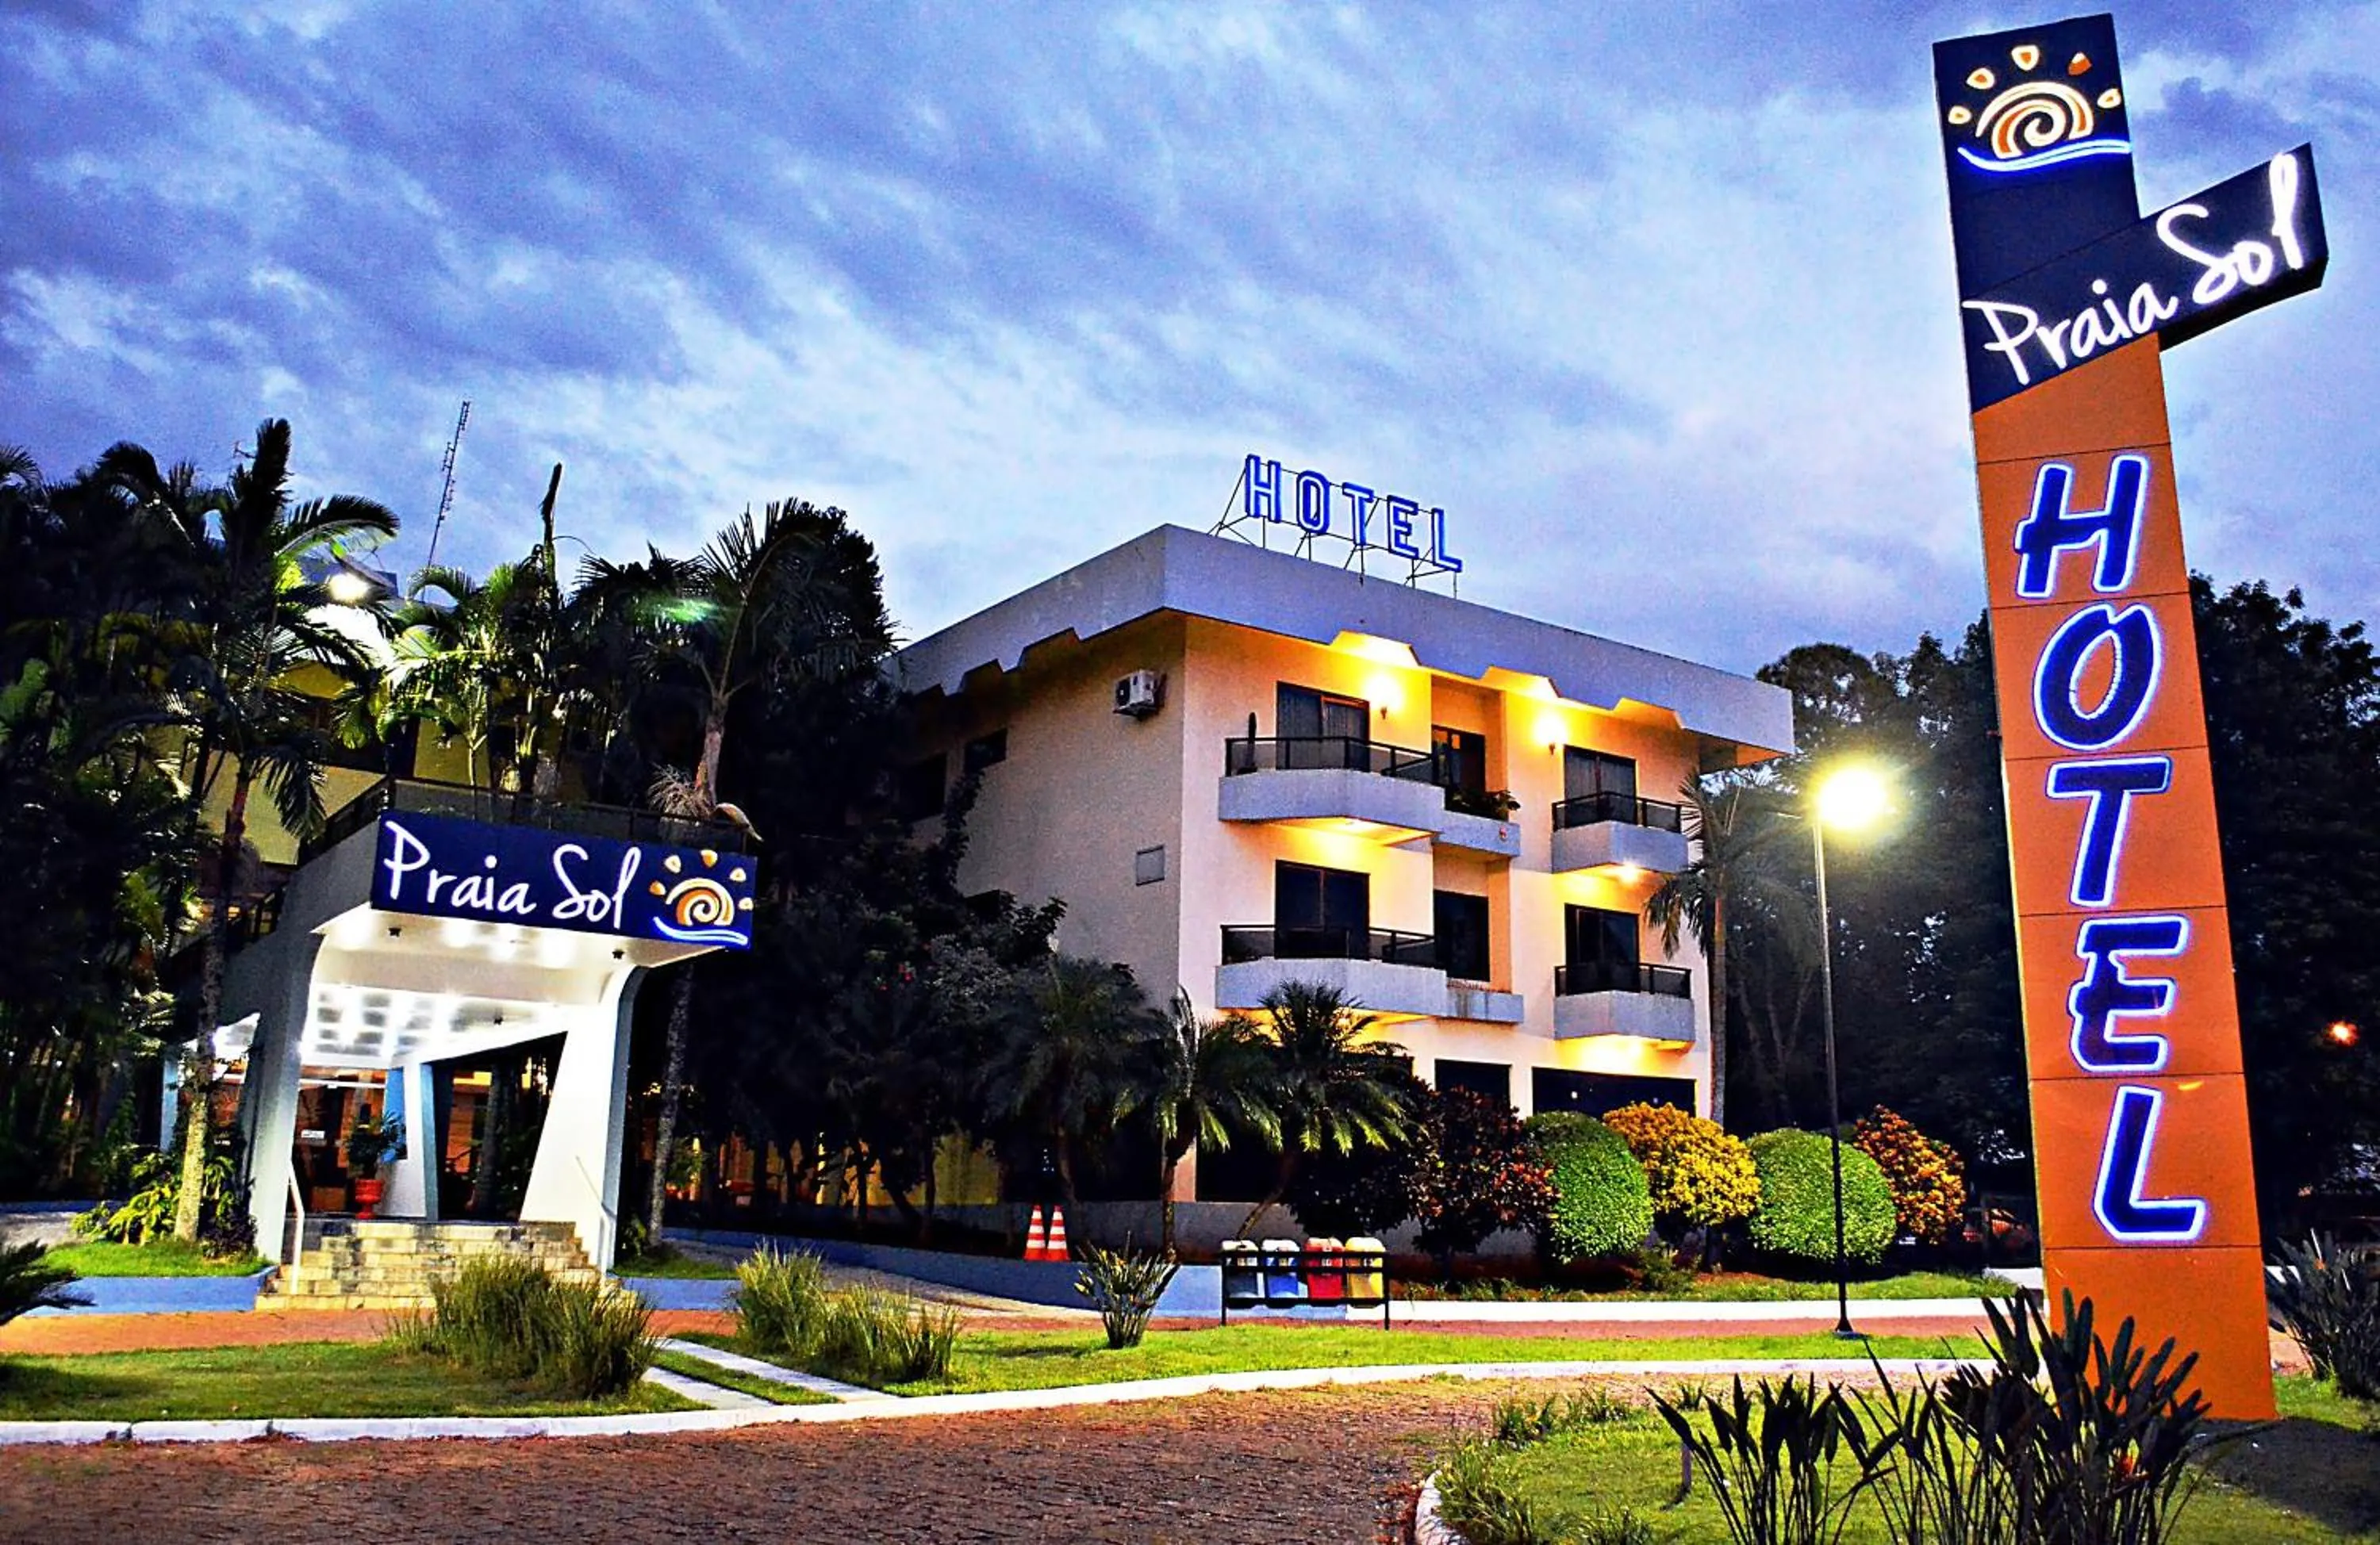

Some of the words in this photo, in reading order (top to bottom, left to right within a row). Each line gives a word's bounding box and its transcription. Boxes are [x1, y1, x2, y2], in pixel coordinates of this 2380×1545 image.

[1963, 279, 2179, 385] Praia
[2156, 152, 2303, 305] Sol
[1245, 453, 1463, 573] HOTEL
[383, 820, 537, 914] Praia
[552, 843, 643, 930] Sol
[2014, 454, 2208, 1243] HOTEL
